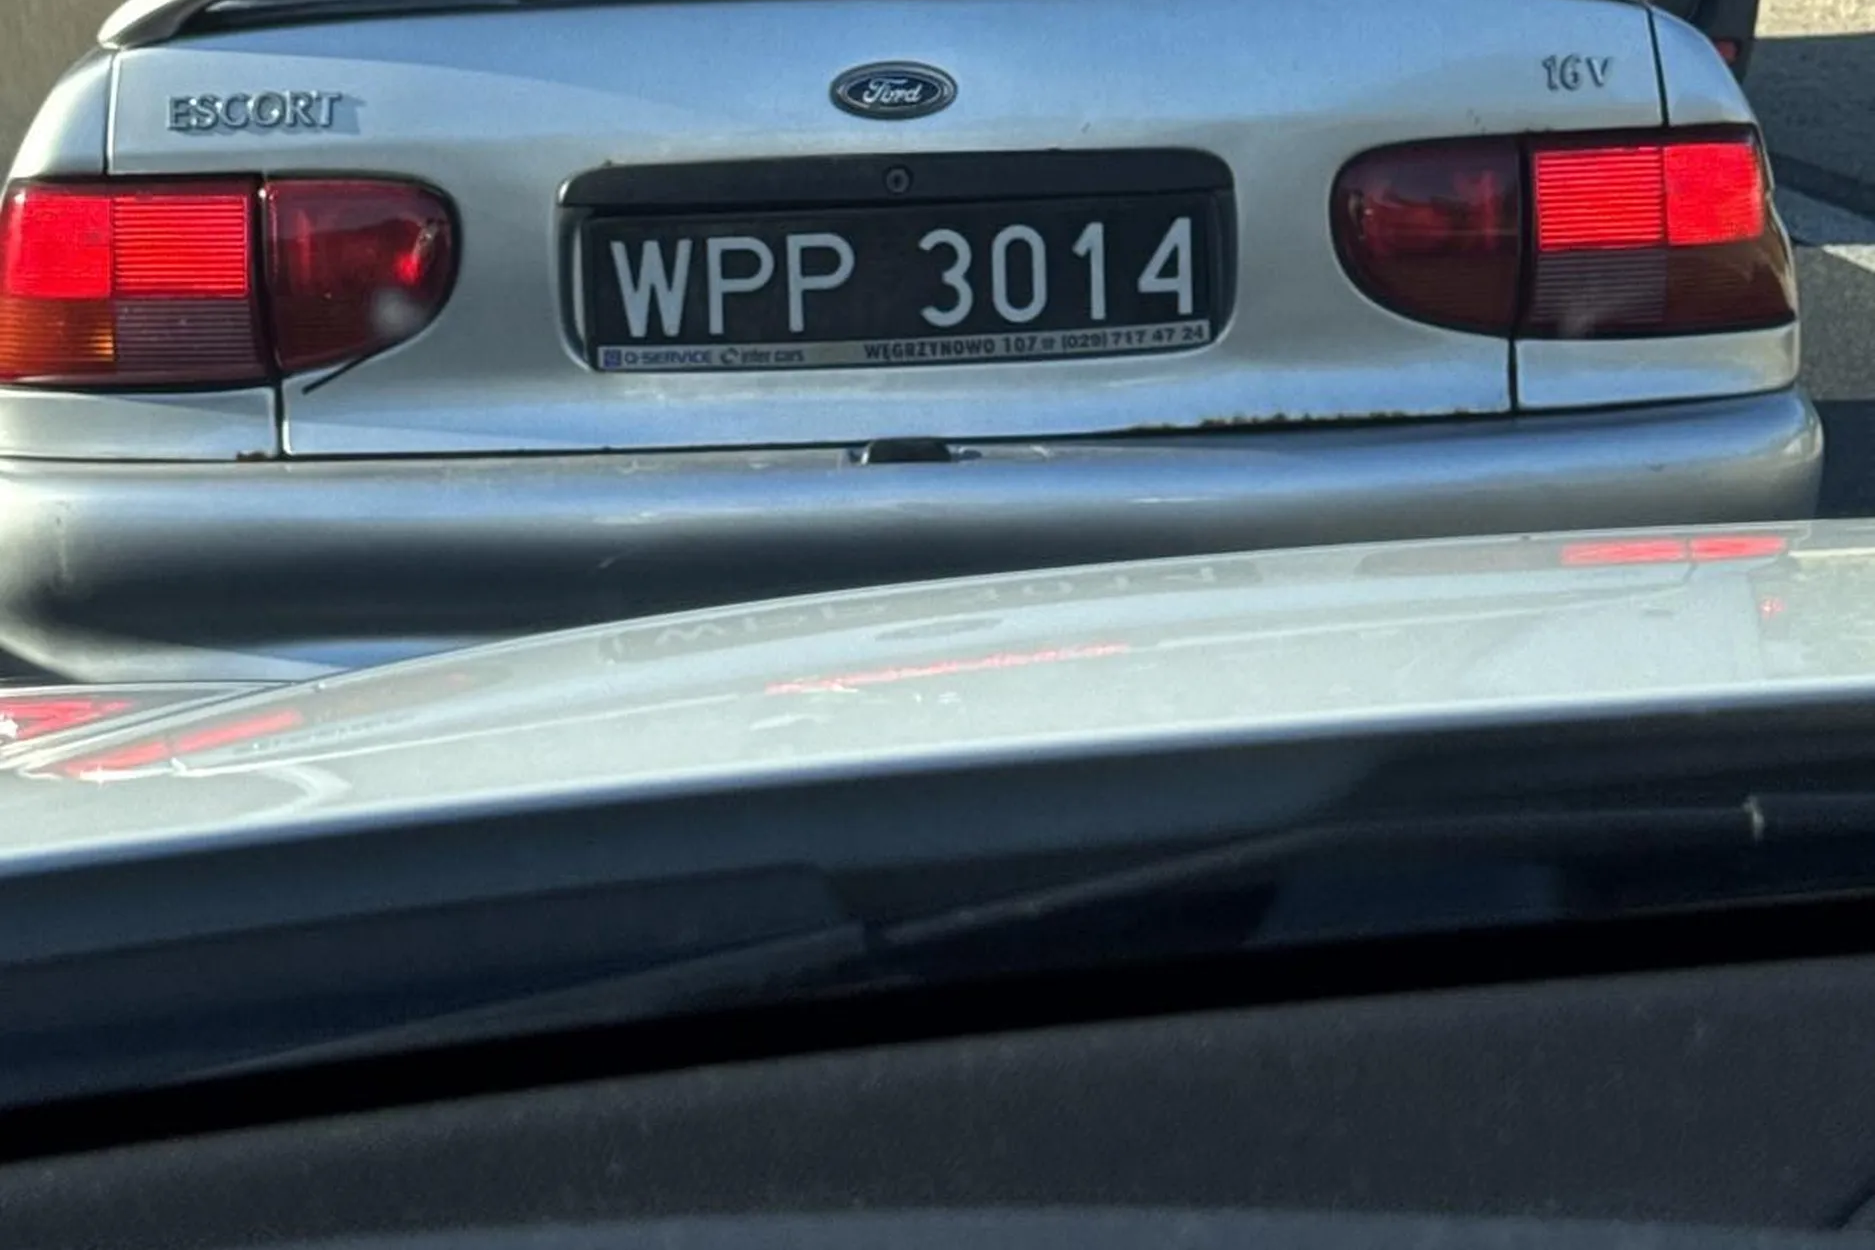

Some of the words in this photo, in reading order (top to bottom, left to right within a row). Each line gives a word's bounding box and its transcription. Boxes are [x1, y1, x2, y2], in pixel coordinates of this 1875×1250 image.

[861, 77, 923, 104] Ford
[1541, 54, 1614, 91] 16V
[166, 90, 344, 131] ESCORT
[609, 232, 856, 338] WPP
[918, 216, 1194, 328] 3014
[863, 338, 995, 359] WĘGRZYNOWO
[1003, 334, 1035, 352] 107
[1111, 329, 1147, 346] 717
